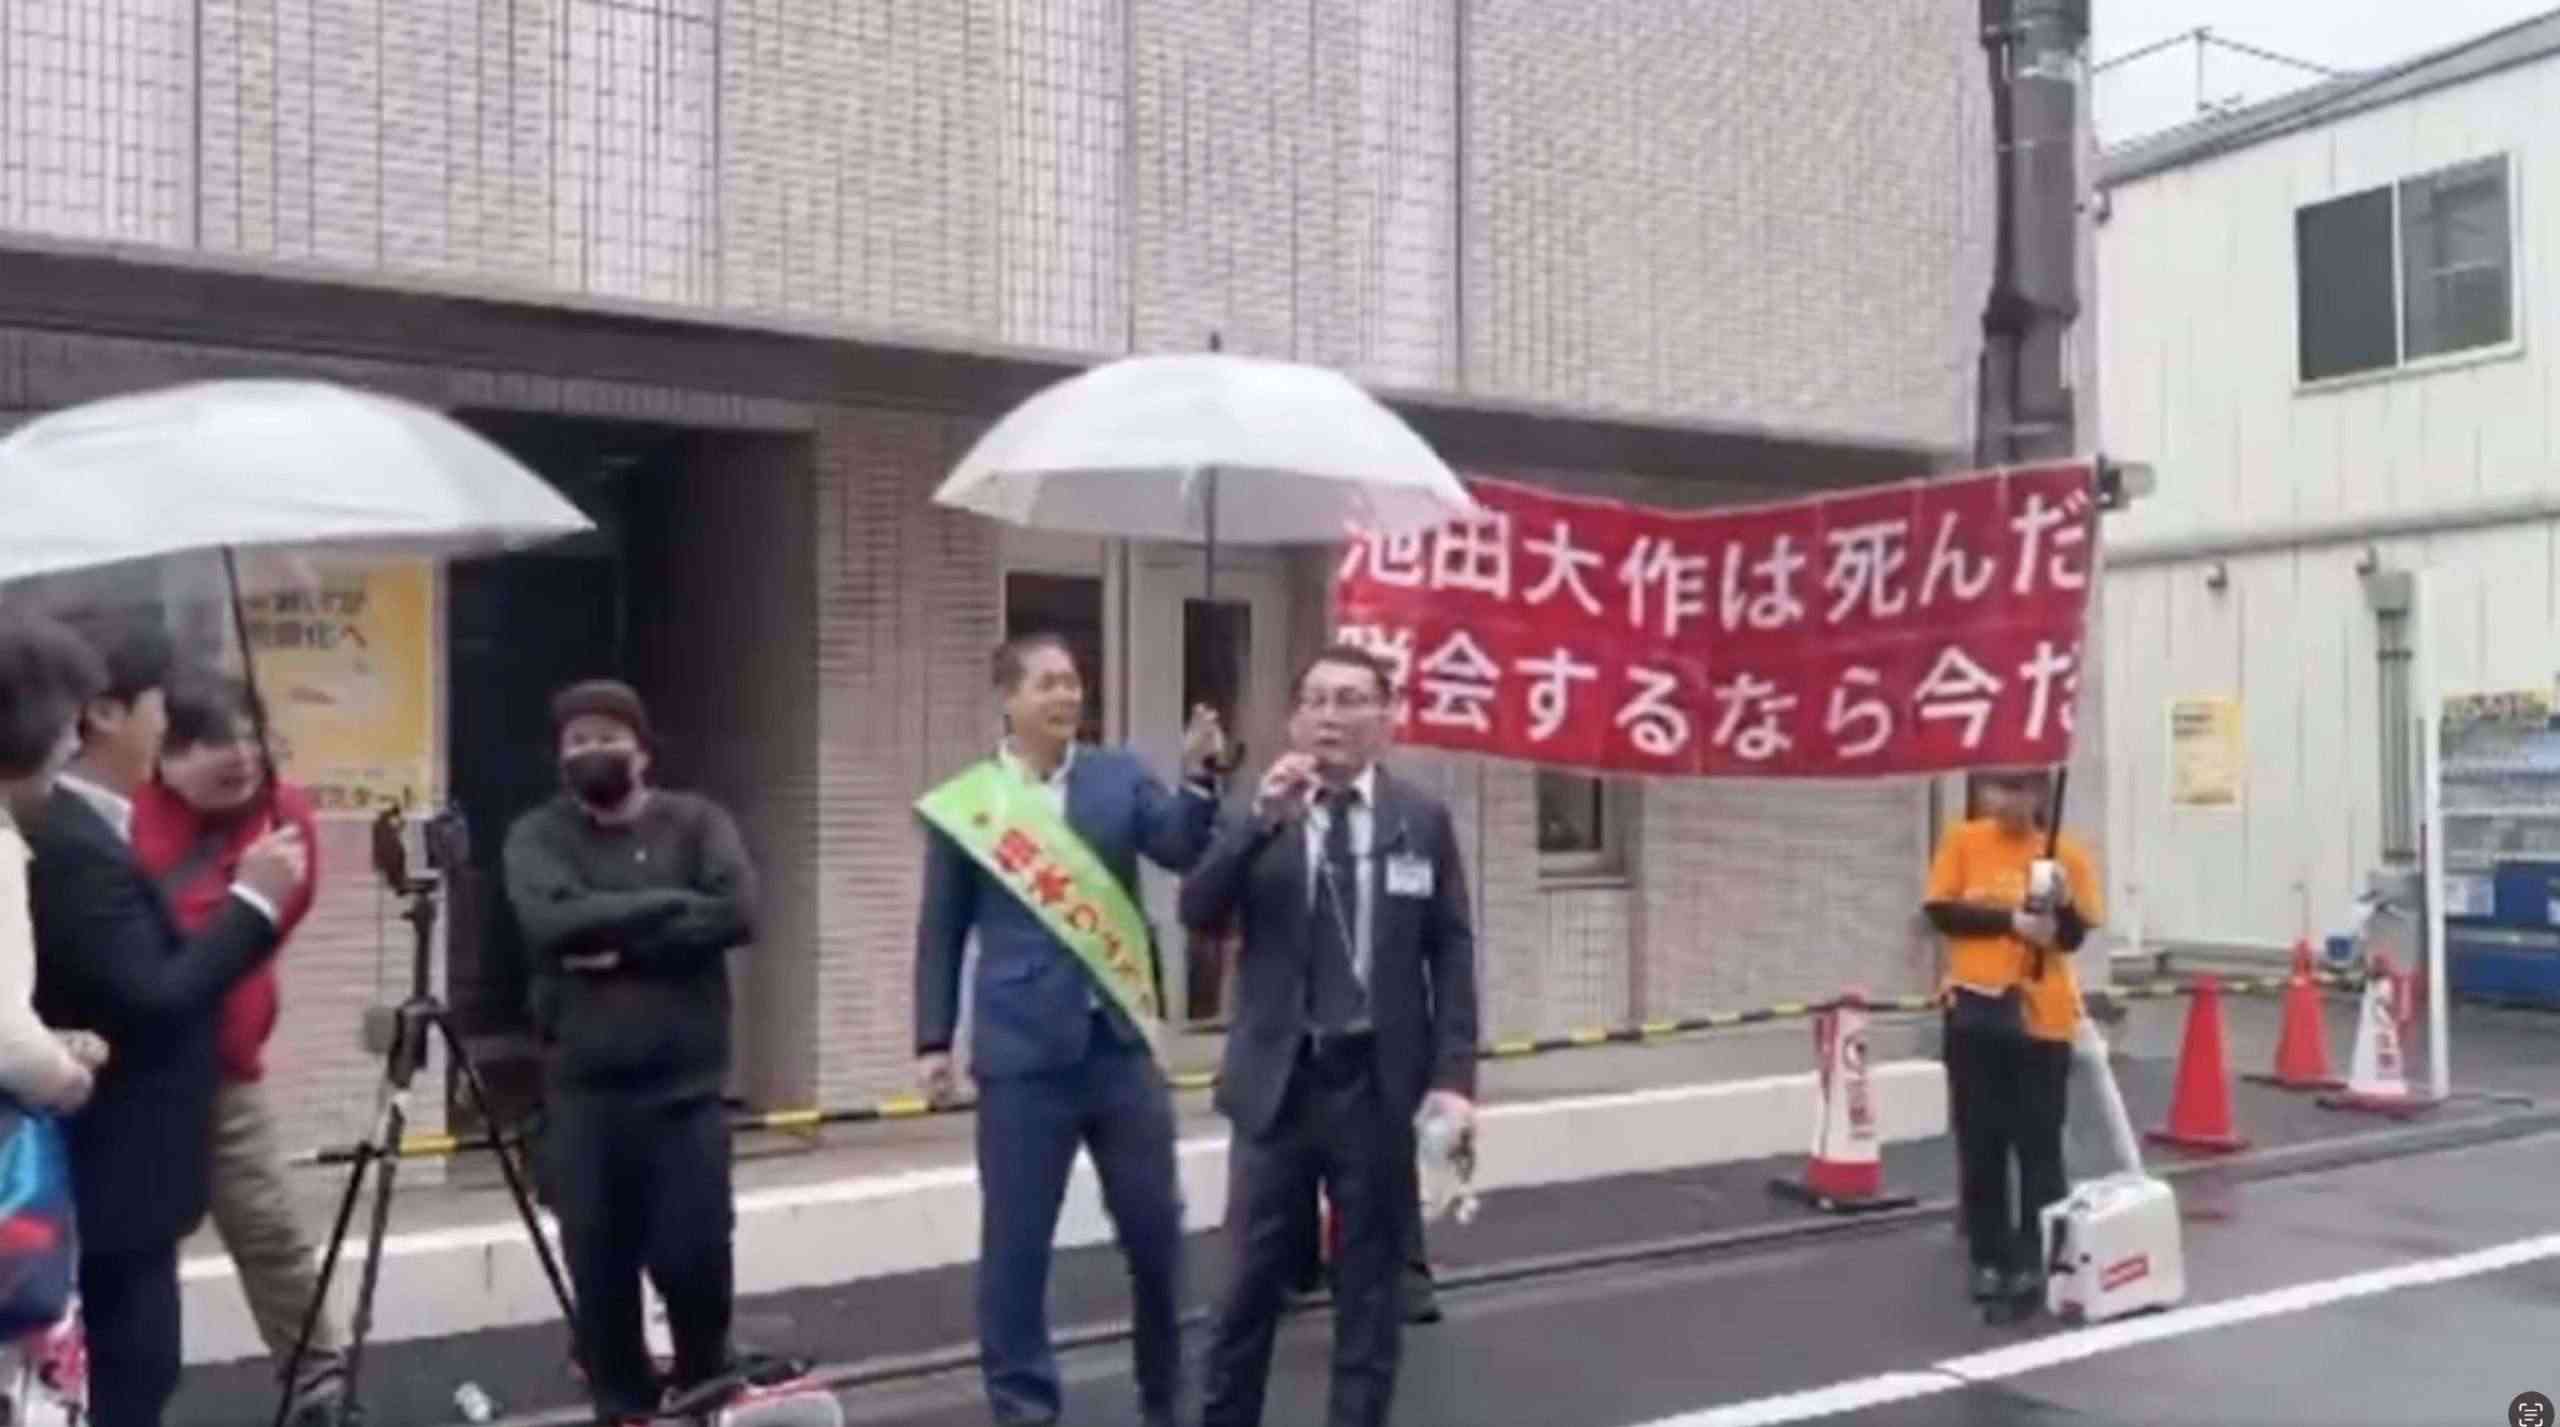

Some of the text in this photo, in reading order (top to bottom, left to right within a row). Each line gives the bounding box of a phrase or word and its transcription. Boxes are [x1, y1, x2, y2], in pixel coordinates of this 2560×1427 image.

[1338, 489, 2088, 636] 池田大作は死んだ
